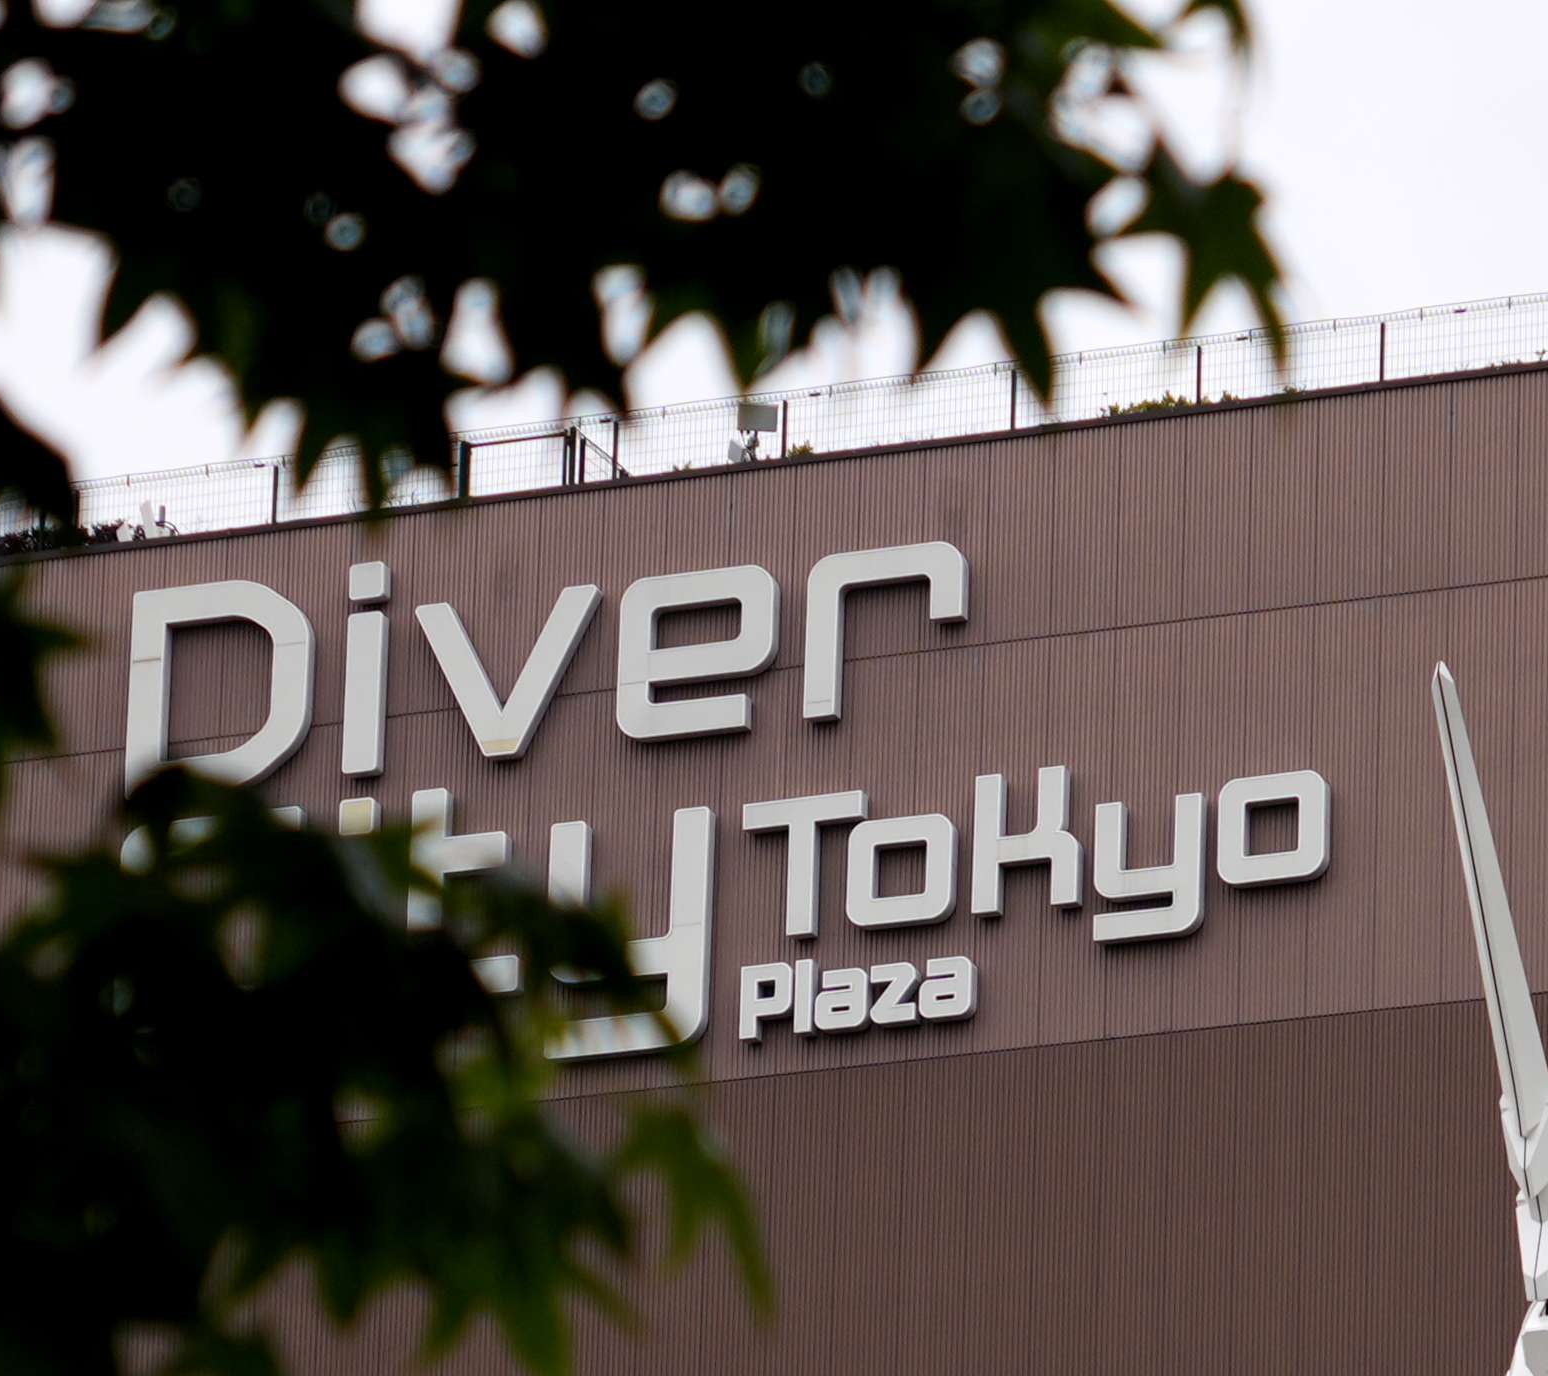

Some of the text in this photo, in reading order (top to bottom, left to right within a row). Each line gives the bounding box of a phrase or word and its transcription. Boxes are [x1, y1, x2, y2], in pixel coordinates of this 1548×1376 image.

[124, 541, 969, 794] Diver
[741, 765, 1331, 944] Tokyo
[738, 954, 978, 1044] Plaza
